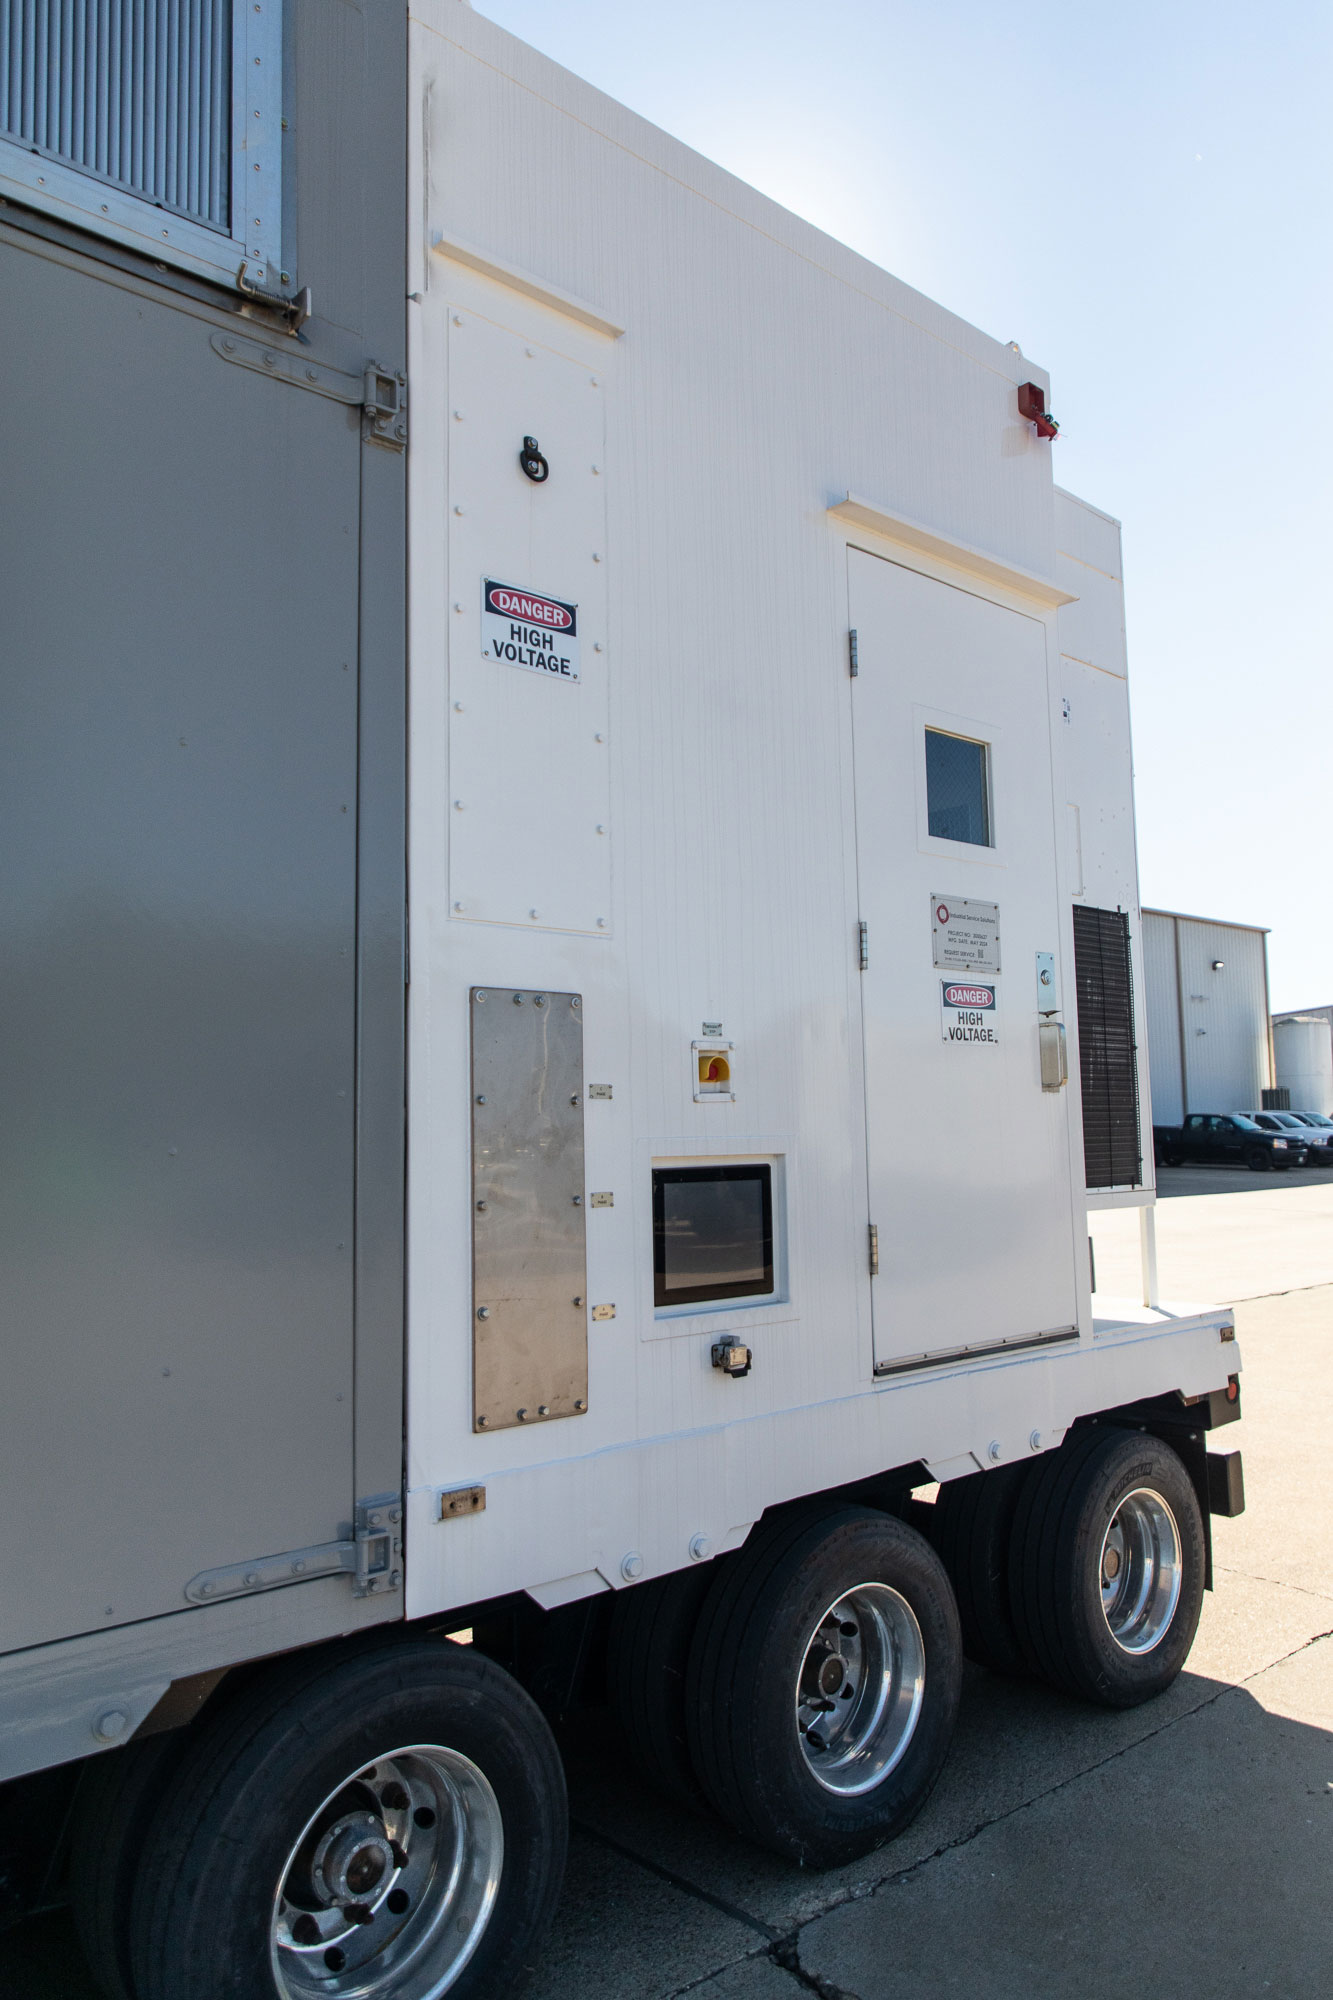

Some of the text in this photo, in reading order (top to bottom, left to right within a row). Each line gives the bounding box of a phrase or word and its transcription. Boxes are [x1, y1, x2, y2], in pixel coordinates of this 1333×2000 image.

[499, 592, 564, 625] DANGER
[510, 623, 554, 651] HIGH
[492, 639, 571, 676] VOLTAGE
[967, 914, 980, 922] Service
[950, 989, 988, 1004] DANGER
[958, 1011, 983, 1026] HIGH
[948, 1026, 994, 1042] VOLTAGE
